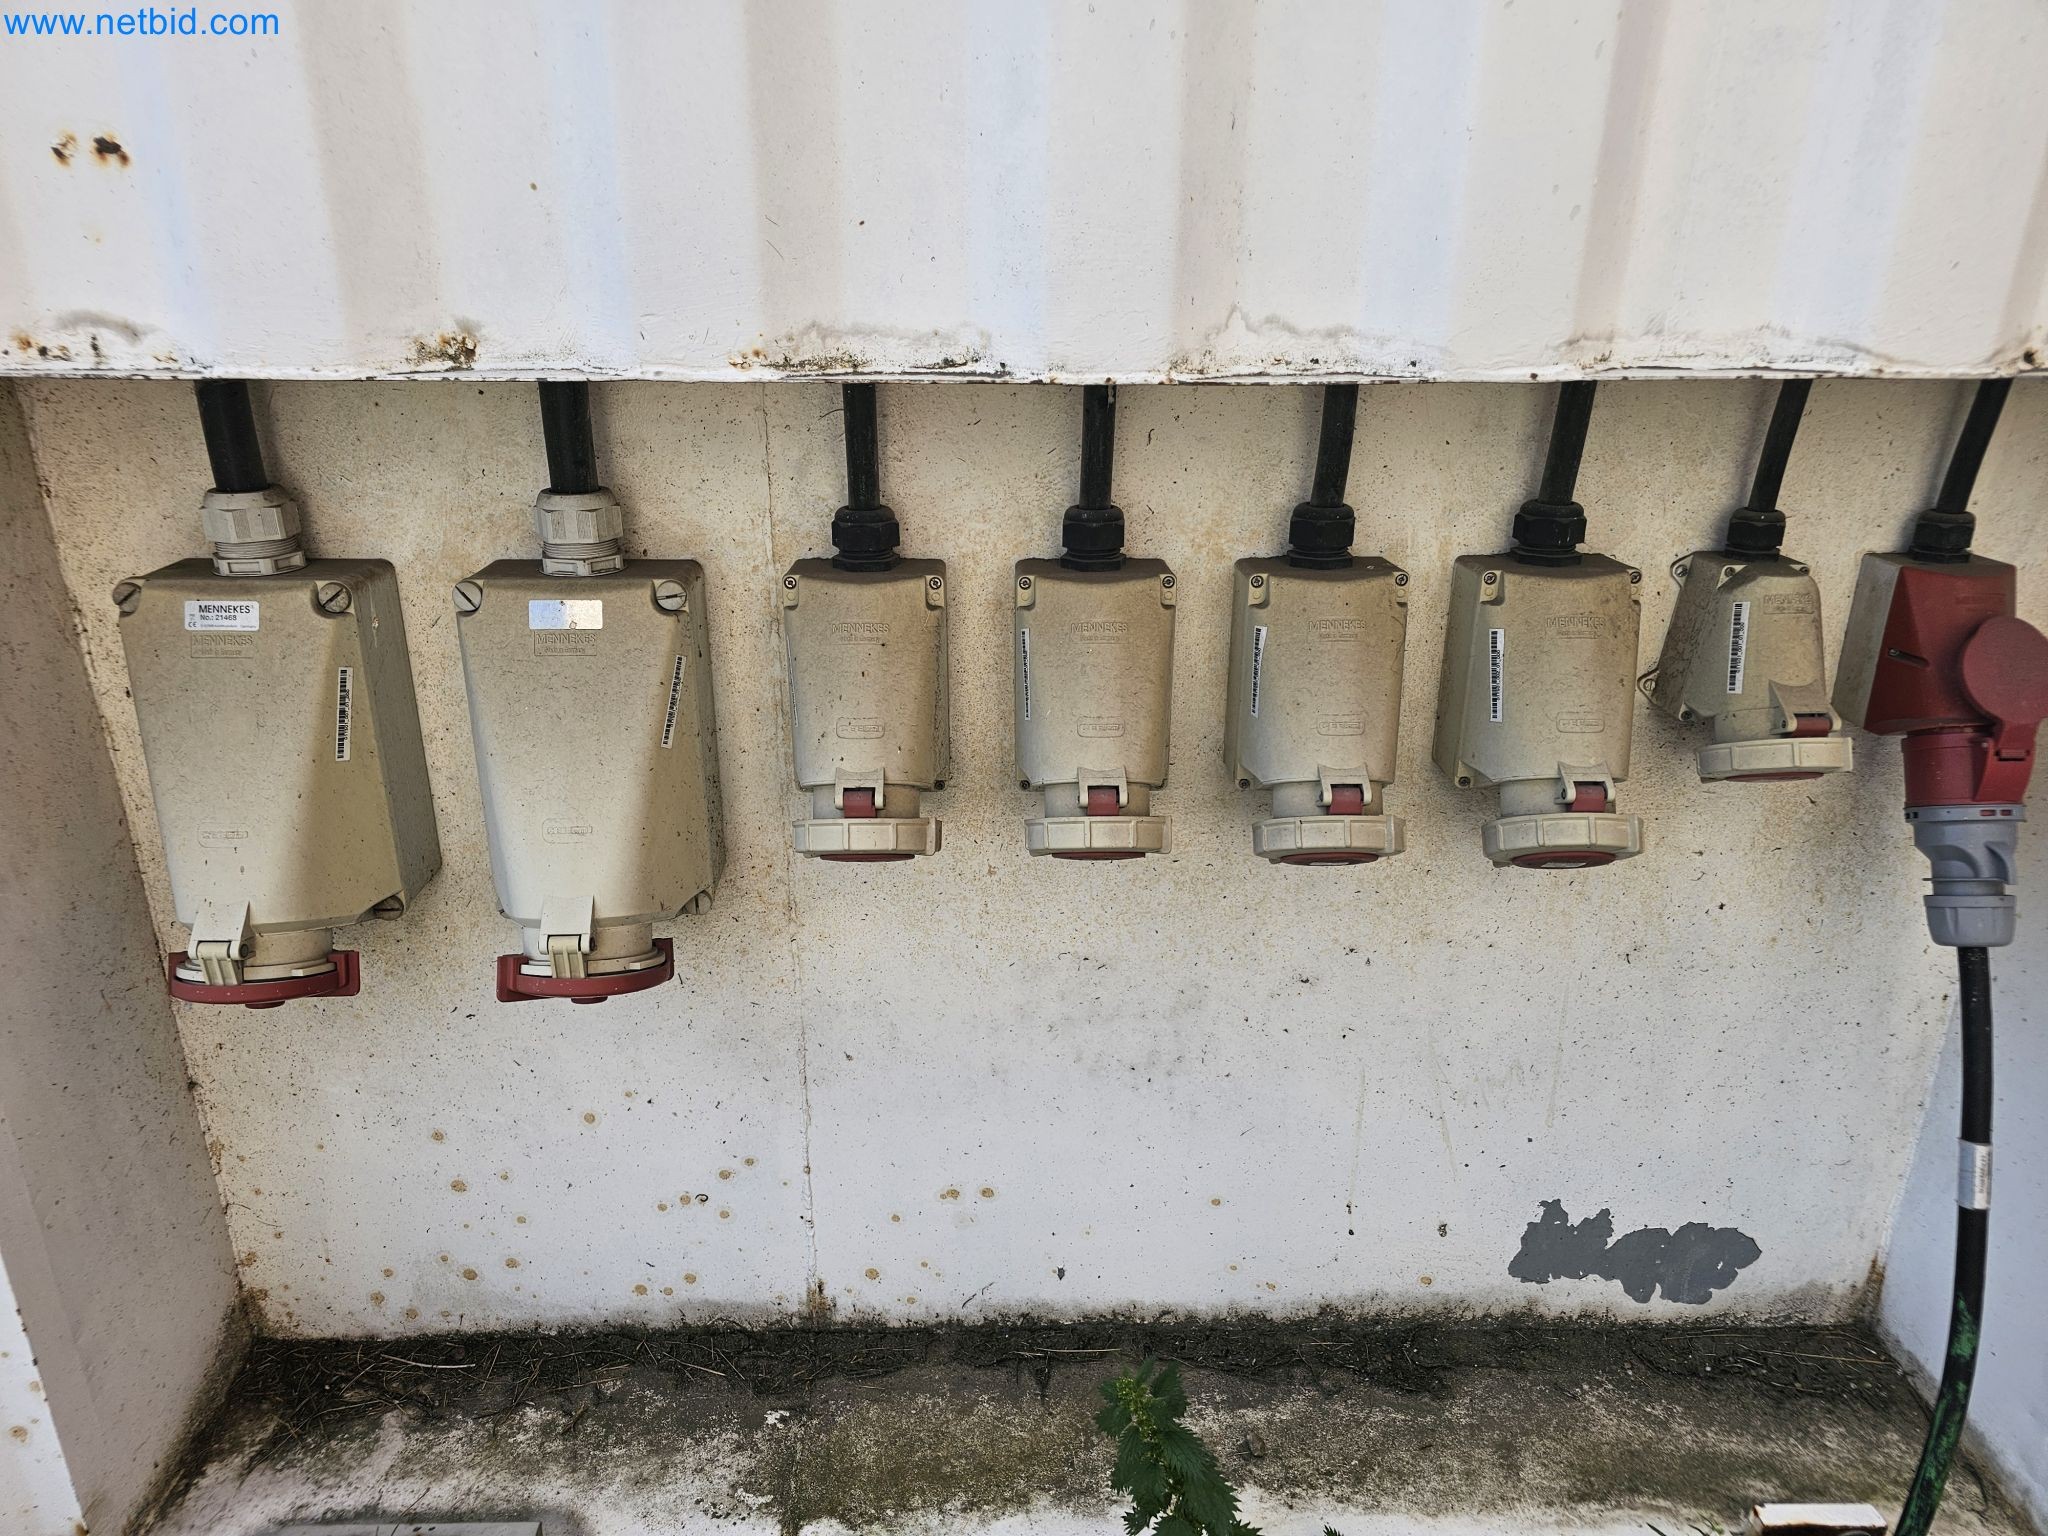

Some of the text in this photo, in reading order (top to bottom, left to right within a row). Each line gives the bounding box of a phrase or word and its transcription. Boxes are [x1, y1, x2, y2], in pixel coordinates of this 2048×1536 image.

[198, 604, 251, 614] MENNEKES
[832, 623, 890, 633] MENNEKES
[1071, 622, 1128, 633] MENNEKES
[1308, 619, 1366, 631] MENNEKES
[1546, 616, 1606, 628] MENNEKES
[193, 634, 253, 646] MENNEKES
[536, 633, 596, 645] MENNEKES
